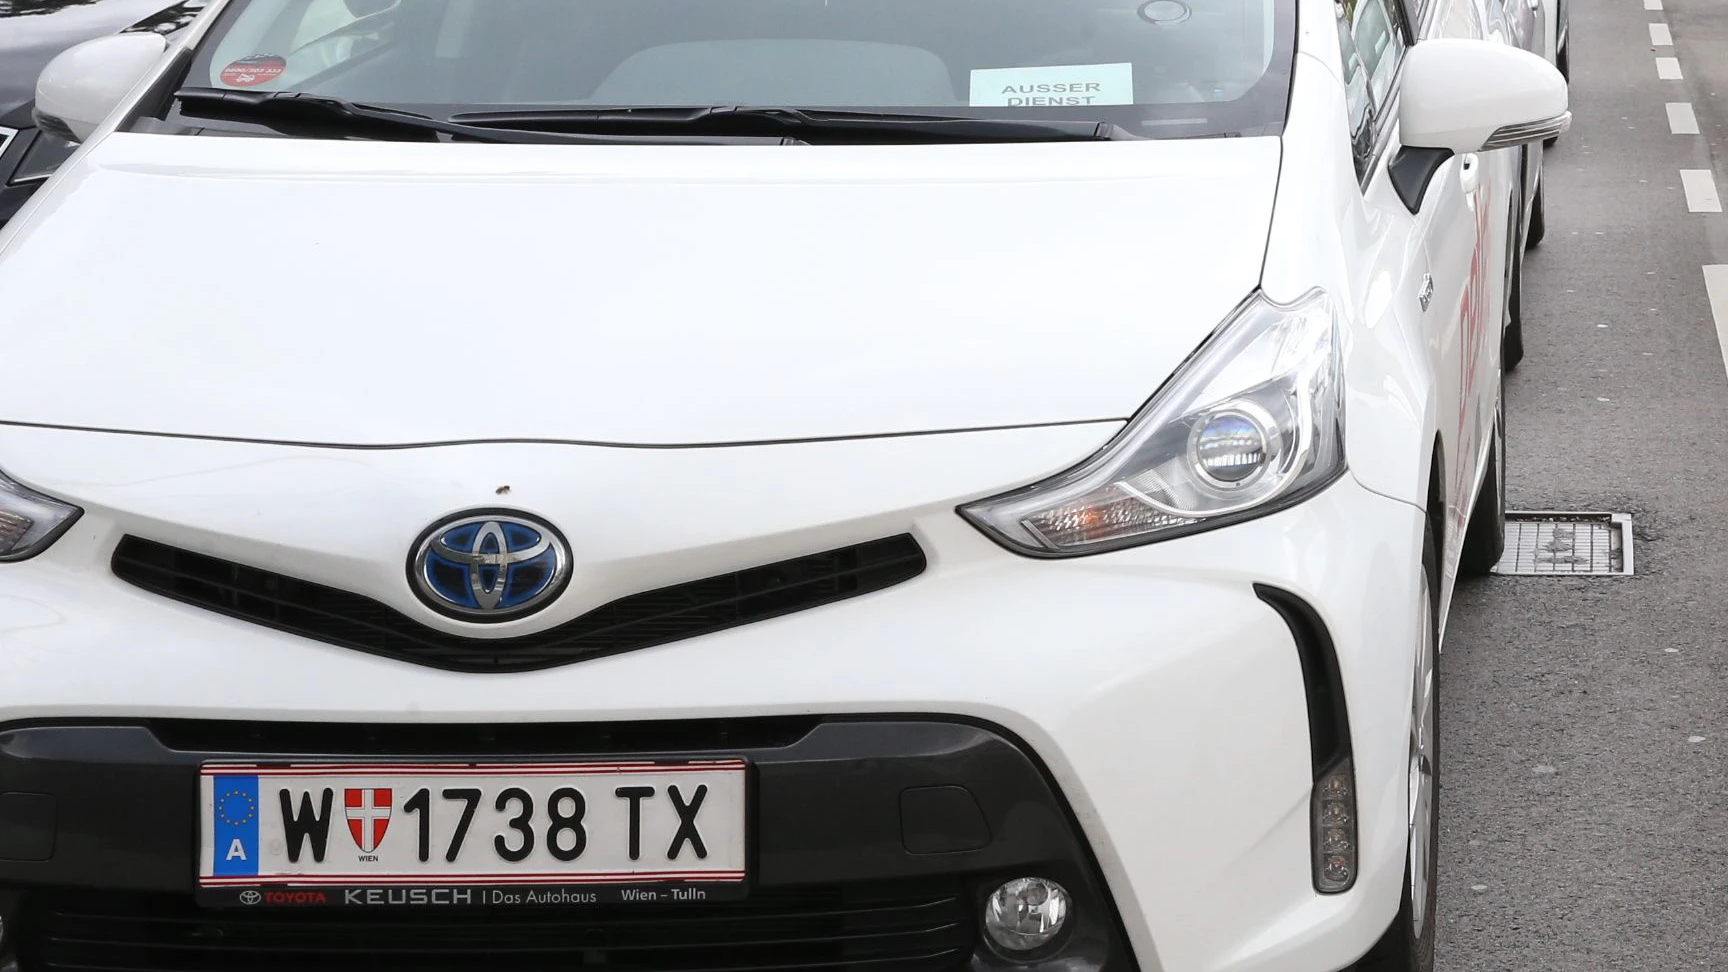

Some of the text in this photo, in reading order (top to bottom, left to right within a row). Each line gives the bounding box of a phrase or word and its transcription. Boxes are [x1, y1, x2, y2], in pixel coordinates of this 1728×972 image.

[1001, 83, 1101, 94] AUSSER
[1007, 96, 1096, 107] DIENST
[279, 784, 709, 863] W 1738 TX
[225, 839, 247, 861] A
[358, 855, 379, 863] WIEN
[264, 892, 327, 904] TOYOTA
[344, 889, 472, 904] KEUSCH
[492, 890, 522, 904] Das
[525, 888, 597, 904] Autohaus
[621, 889, 657, 901] Wien
[671, 887, 706, 901] Tulln
